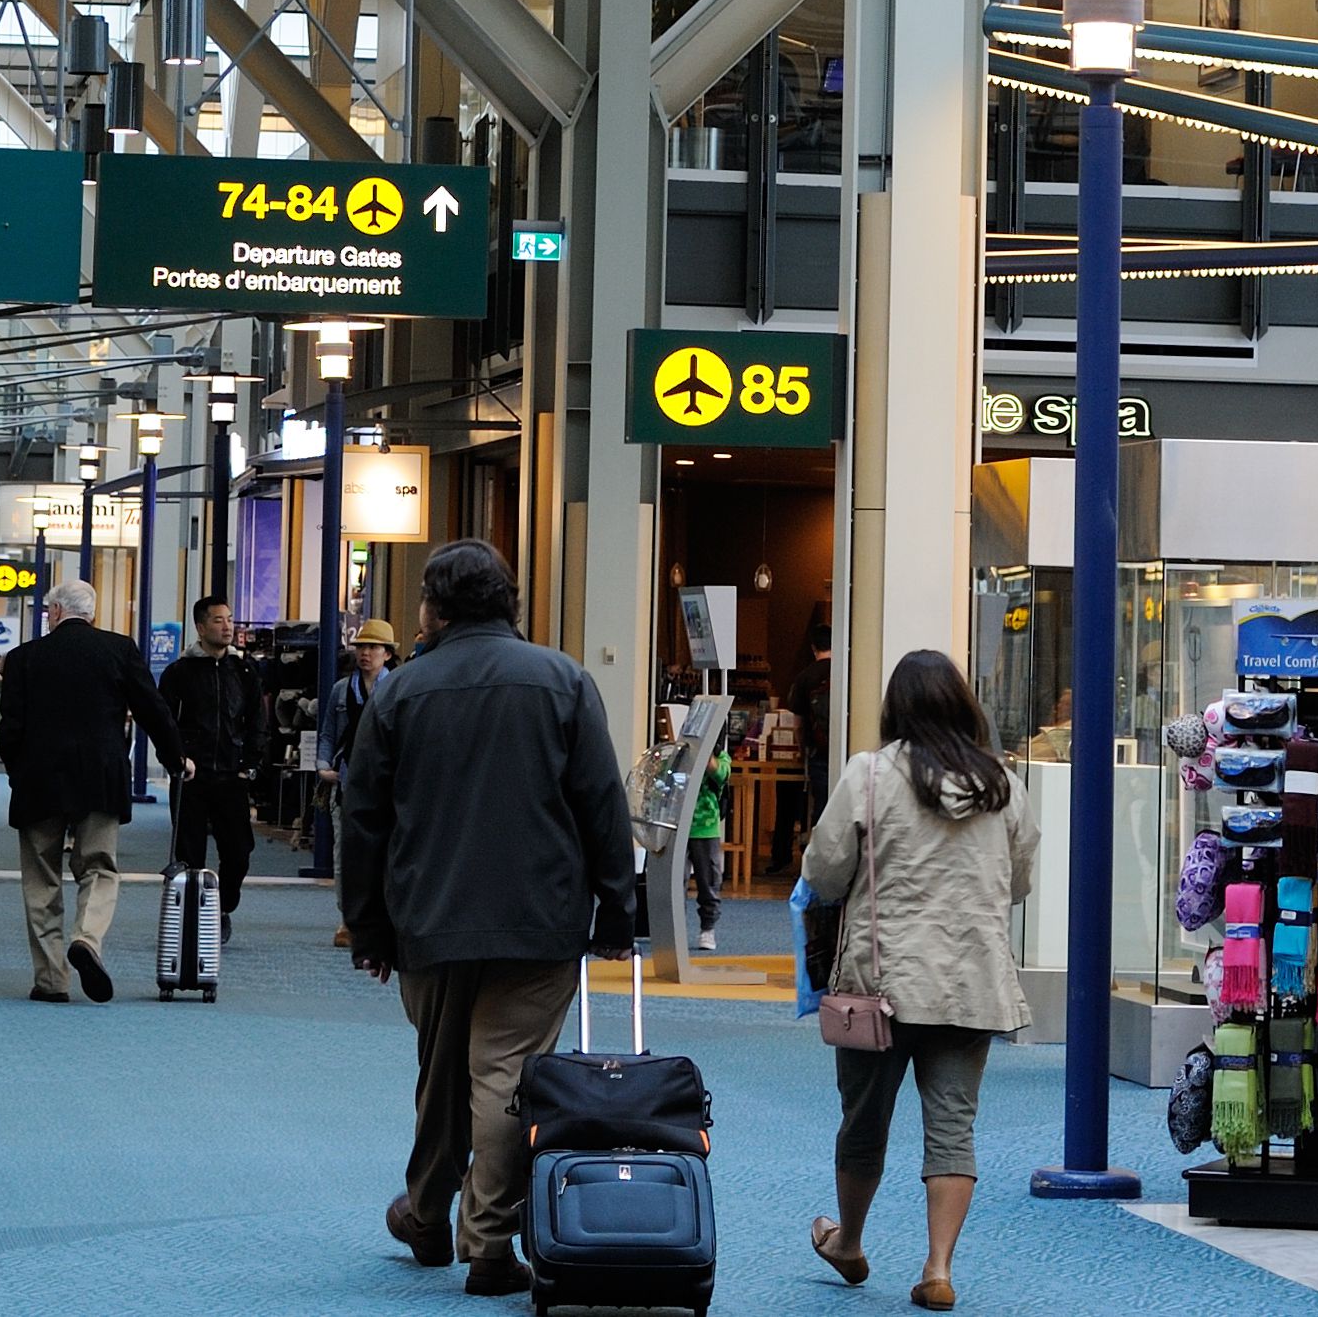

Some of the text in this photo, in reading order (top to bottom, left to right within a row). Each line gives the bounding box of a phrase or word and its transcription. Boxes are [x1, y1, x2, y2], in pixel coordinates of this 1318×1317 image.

[218, 181, 339, 223] 74-84
[233, 240, 402, 269] Departure Gates
[153, 267, 401, 298] Portes d'embarquement
[738, 365, 811, 416] 85
[395, 484, 418, 498] spa
[1242, 654, 1281, 668] Travel
